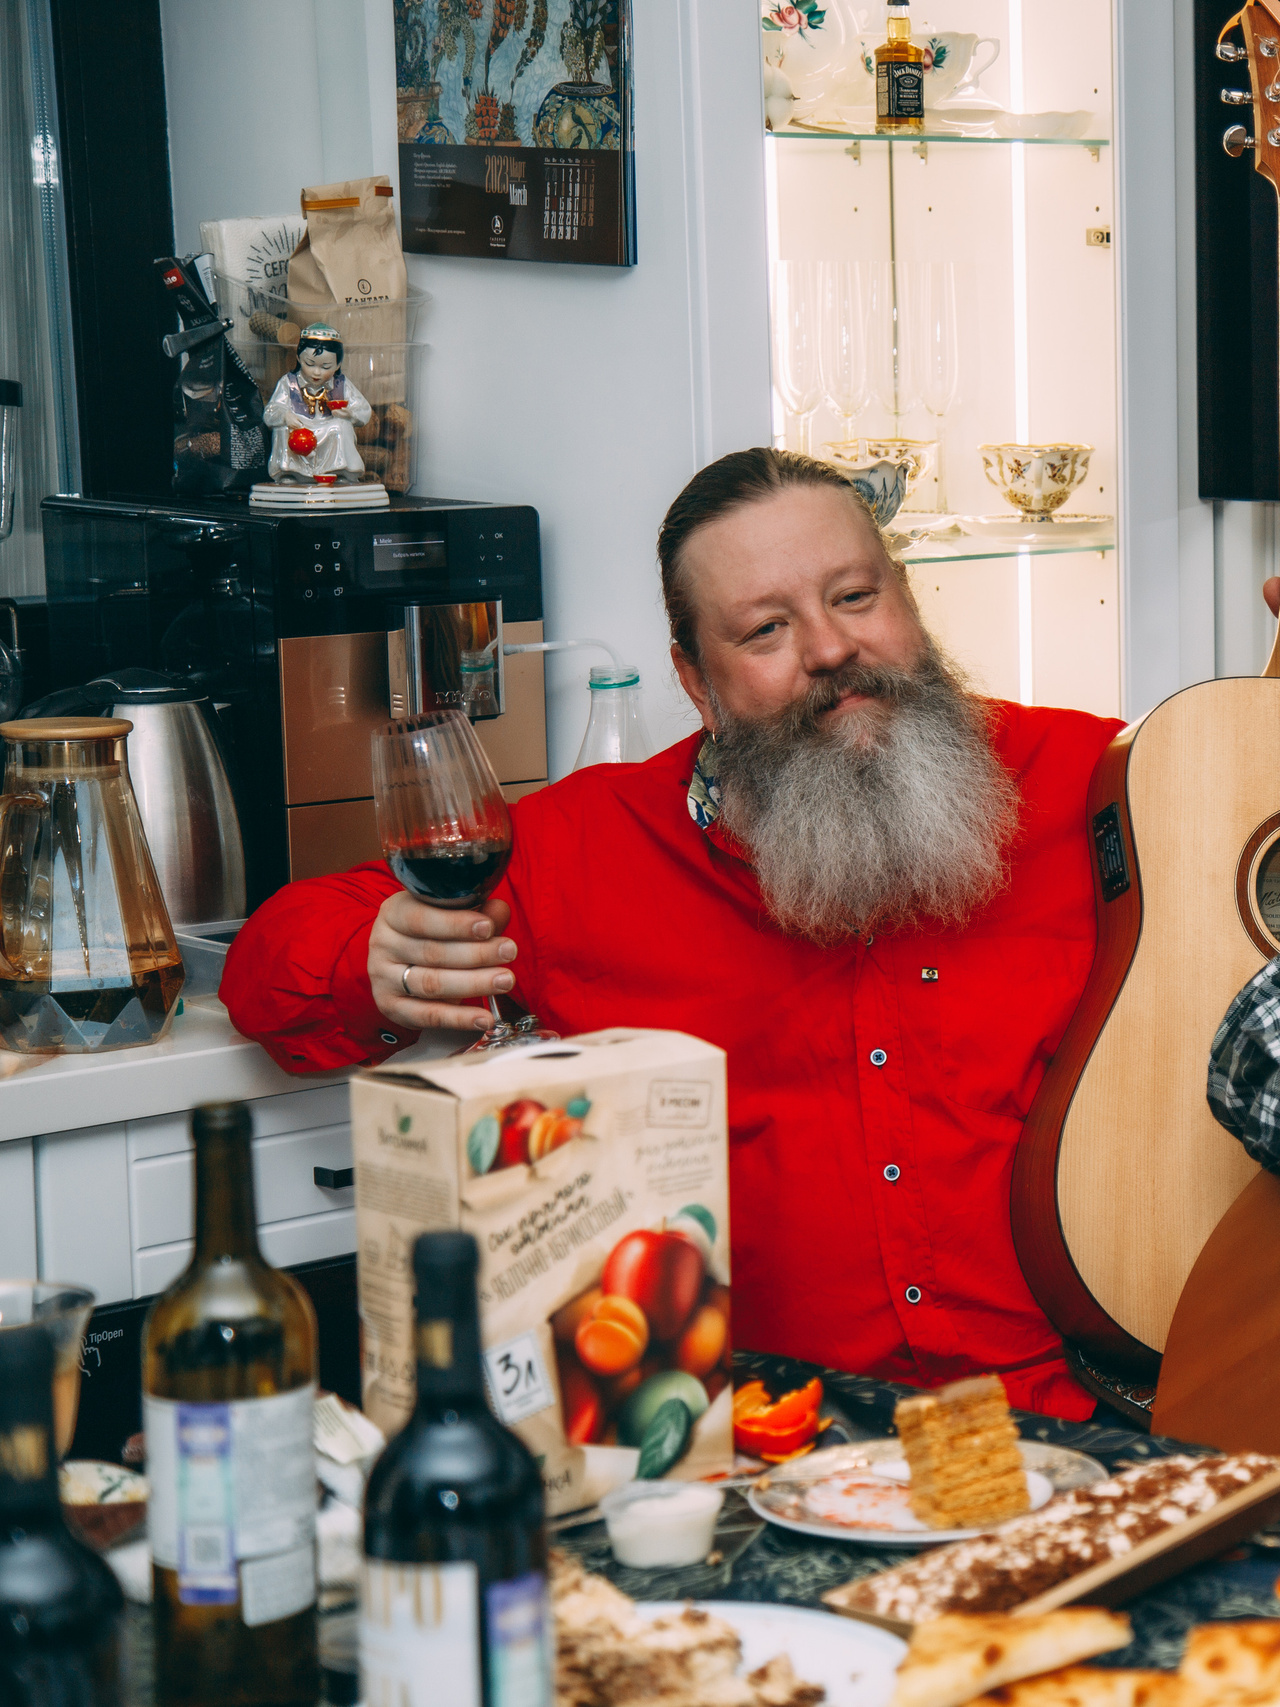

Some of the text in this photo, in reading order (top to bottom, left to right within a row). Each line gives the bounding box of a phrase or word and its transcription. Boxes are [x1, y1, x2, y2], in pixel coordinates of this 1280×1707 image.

[485, 154, 509, 193] 2023
[509, 184, 528, 206] March
[435, 688, 492, 704] Miele
[89, 1329, 124, 1344] TipOpen
